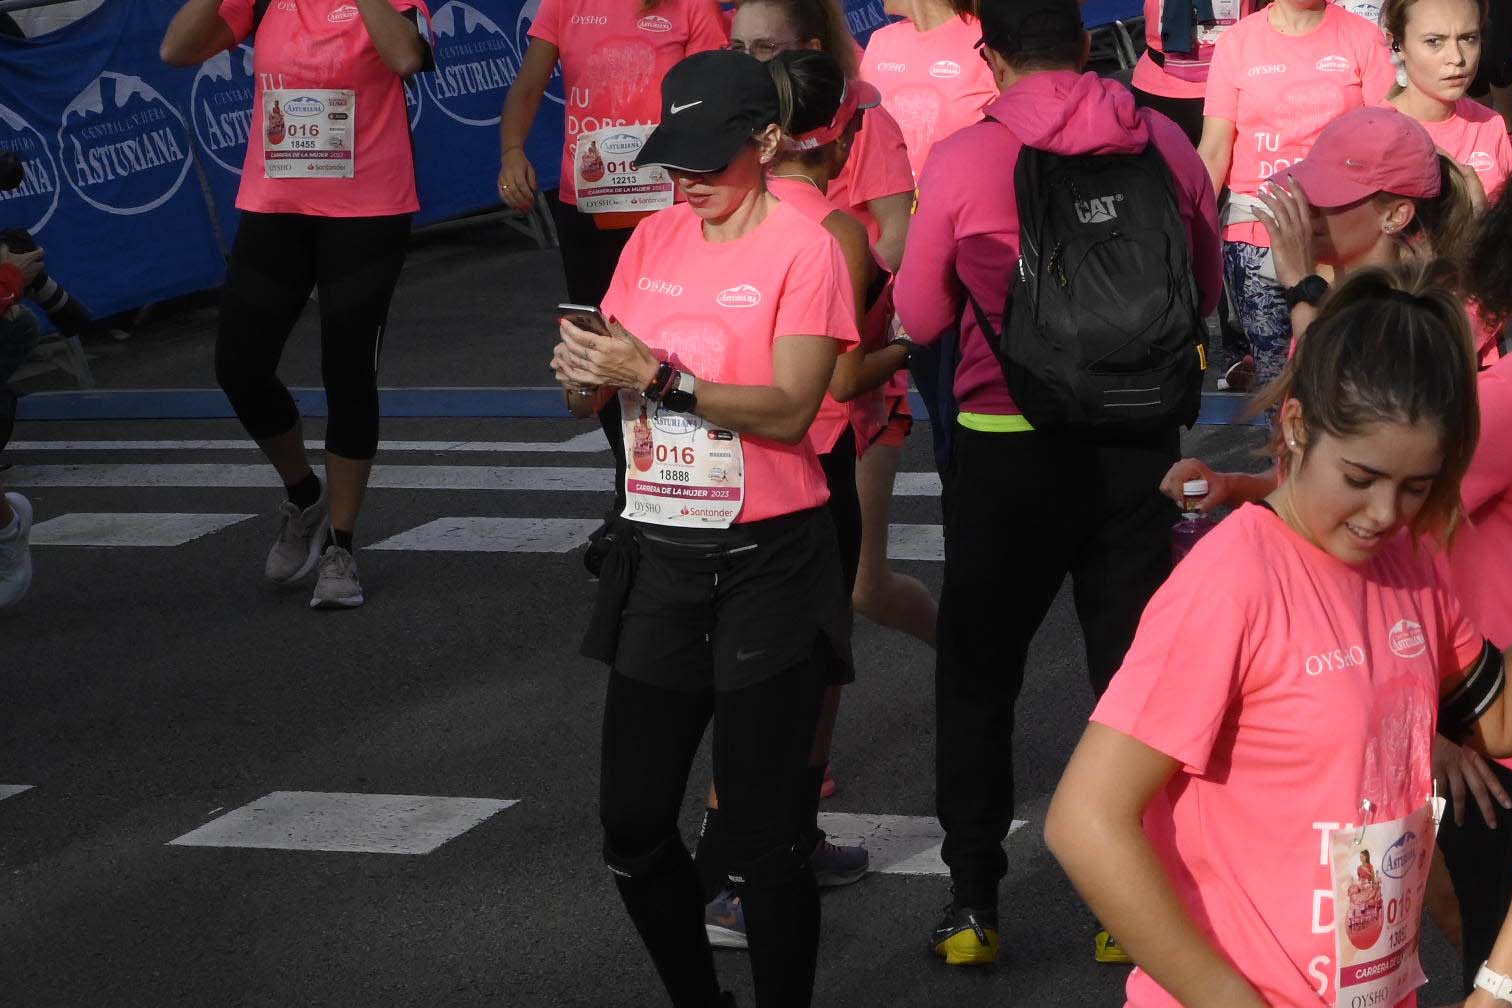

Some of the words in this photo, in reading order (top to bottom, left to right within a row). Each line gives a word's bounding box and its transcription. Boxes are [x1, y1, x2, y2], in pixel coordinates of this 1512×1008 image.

[571, 15, 608, 26] OYSHO
[288, 124, 320, 137] 016
[291, 141, 316, 149] 18455
[1254, 132, 1280, 153] TU
[611, 176, 637, 185] 12213
[1074, 195, 1118, 224] CAT
[656, 444, 695, 465] 016
[660, 469, 690, 482] 18888
[635, 483, 661, 493] CARRERA
[682, 489, 708, 497] MUJER
[634, 501, 661, 513] OYSHO
[690, 507, 733, 517] Santander
[1306, 645, 1365, 676] OYSHO
[1355, 963, 1390, 980] CARRERA
